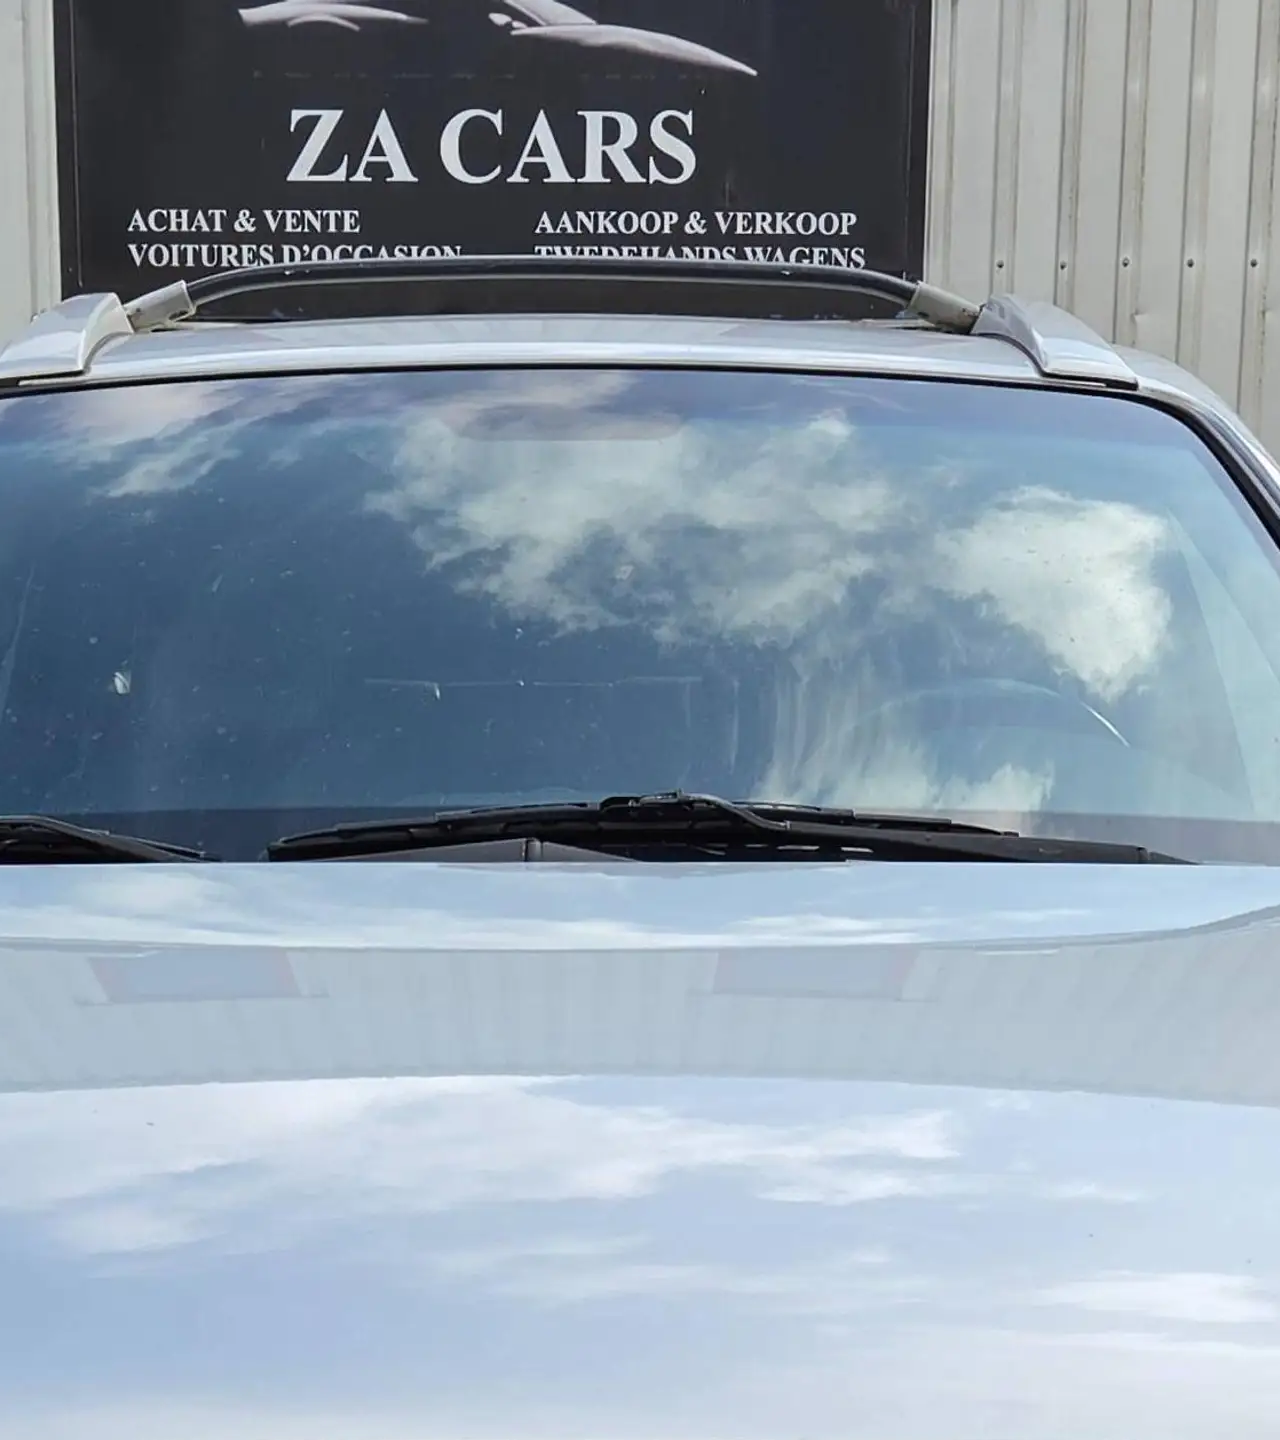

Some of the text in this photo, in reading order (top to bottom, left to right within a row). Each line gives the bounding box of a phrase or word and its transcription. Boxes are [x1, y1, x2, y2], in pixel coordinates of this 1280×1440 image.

[286, 108, 697, 184] ZA CARS
[127, 208, 361, 233] ACHAT & VENTE
[534, 210, 857, 235] AANKOOP & VERKOOP
[127, 243, 275, 268] VOITURES
[743, 246, 866, 270] WAGENS
